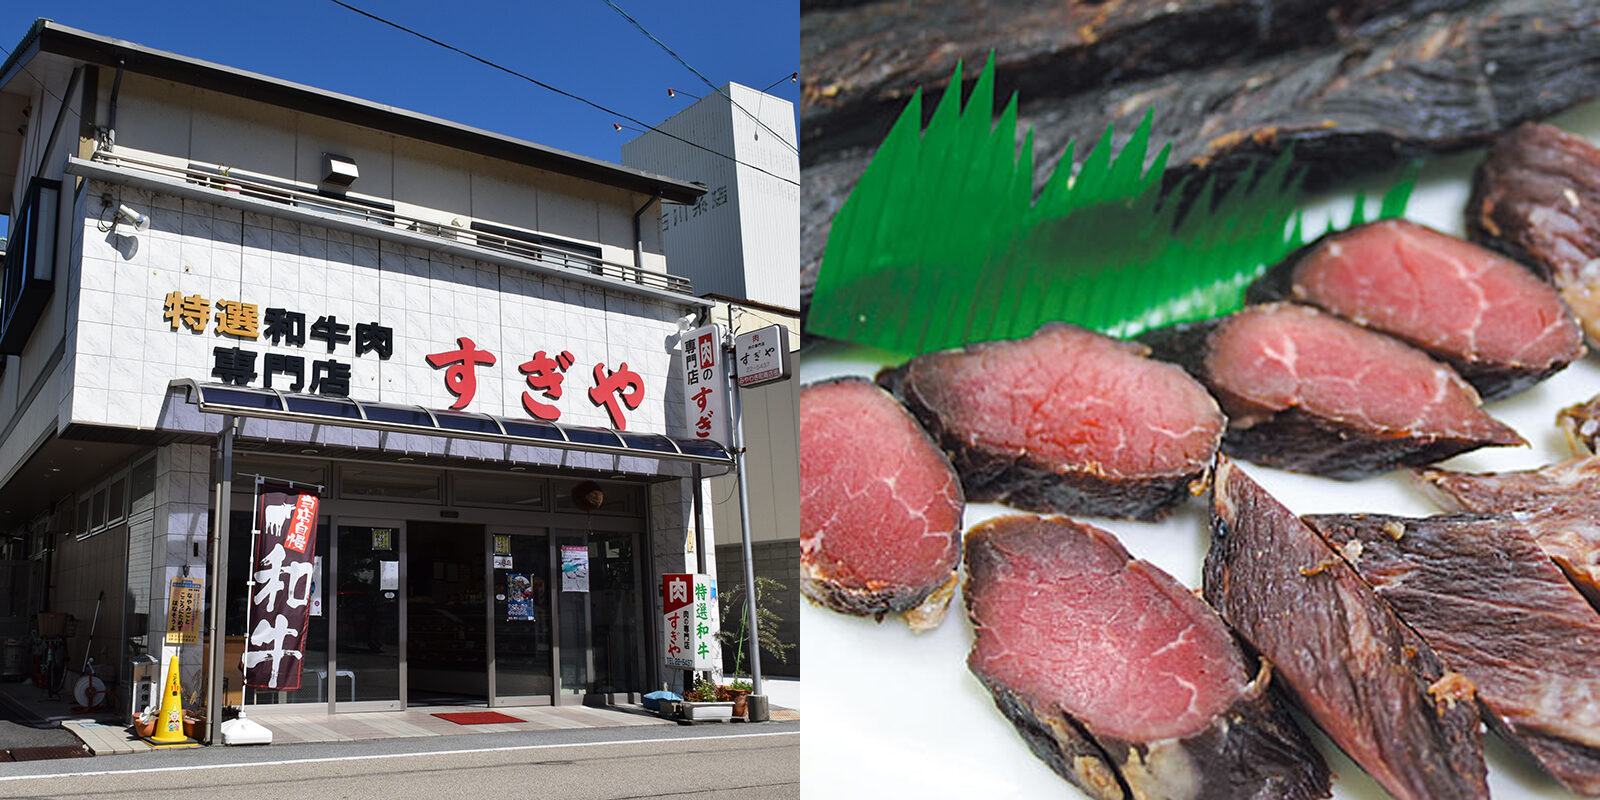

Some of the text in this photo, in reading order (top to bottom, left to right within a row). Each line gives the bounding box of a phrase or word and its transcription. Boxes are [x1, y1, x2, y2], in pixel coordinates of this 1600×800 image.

[164, 291, 393, 360] 特選和牛肉
[212, 346, 351, 397] 専門店
[685, 339, 699, 386] 専門店
[700, 336, 713, 380] 肉の
[740, 347, 775, 365] すぎや
[425, 337, 645, 431] すぎや
[286, 495, 316, 550] 当店自慢
[242, 543, 313, 688] 和牛
[669, 577, 687, 603] 肉
[668, 612, 681, 658] すぎや
[695, 583, 710, 660] 特選和牛
